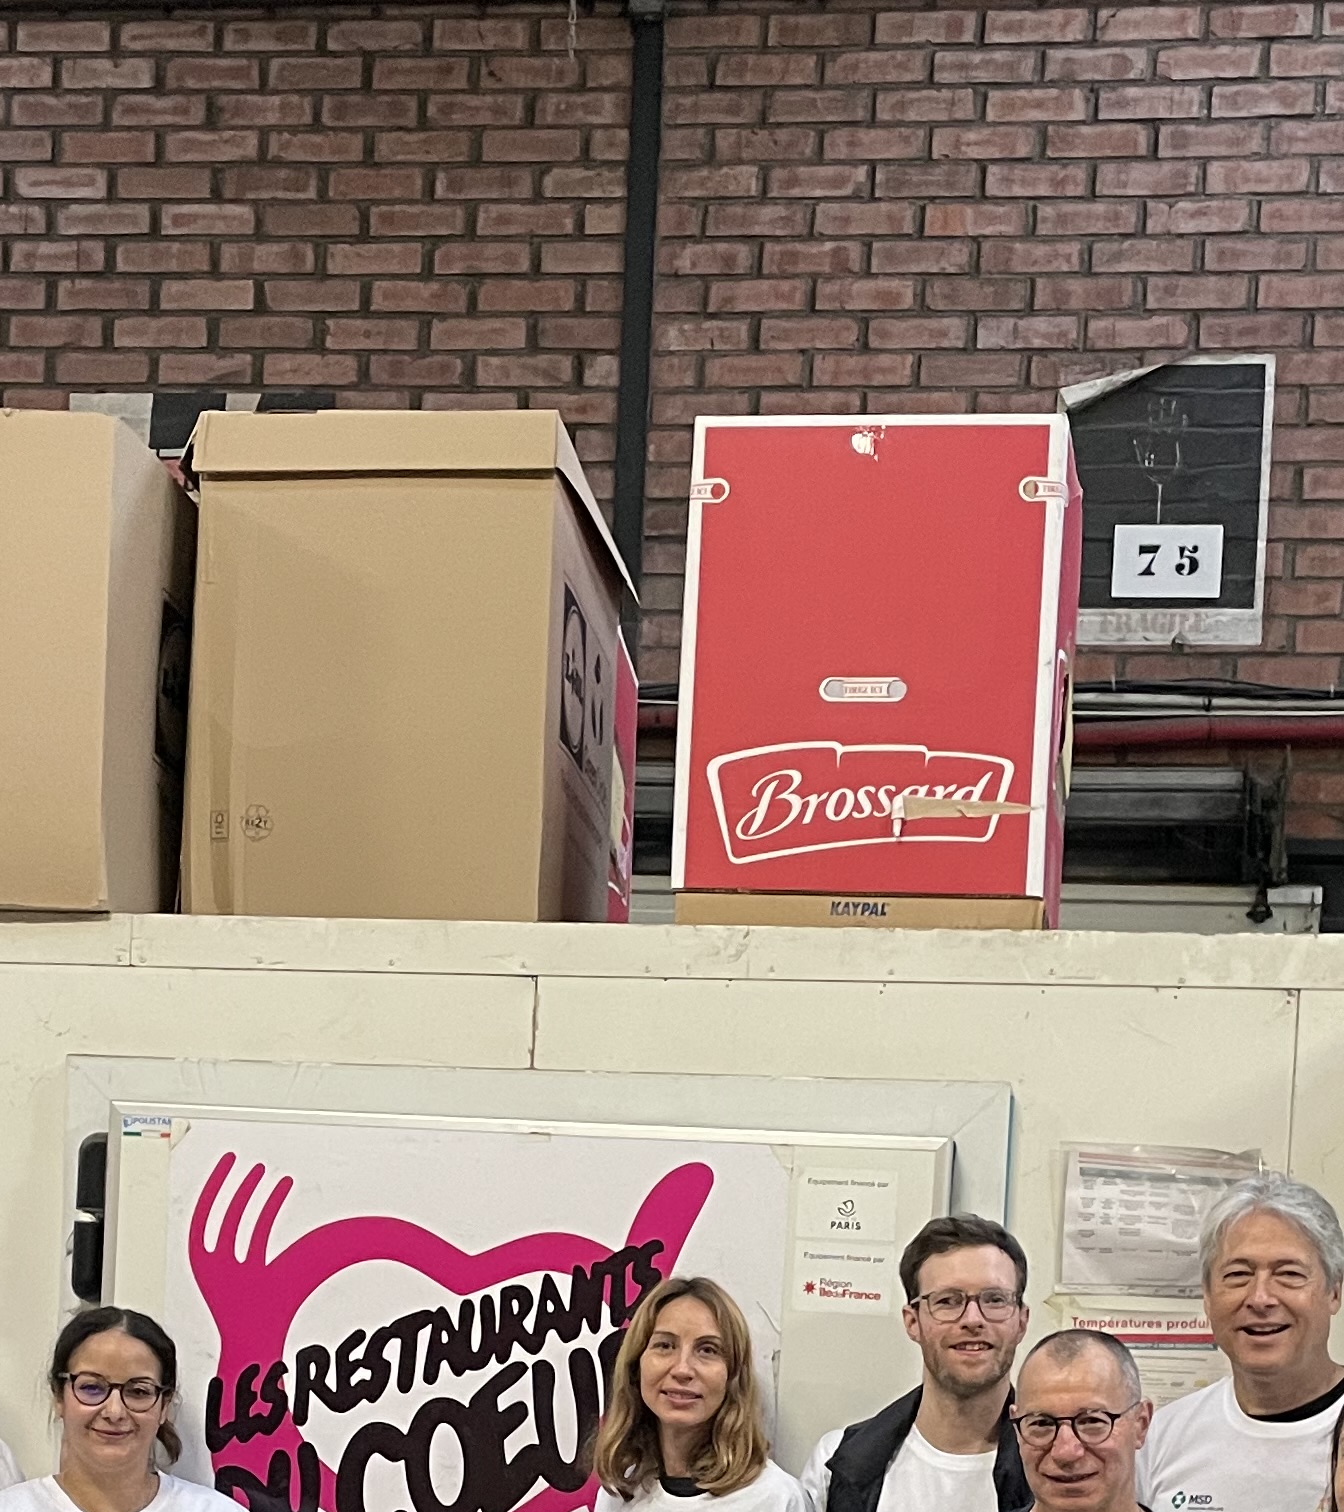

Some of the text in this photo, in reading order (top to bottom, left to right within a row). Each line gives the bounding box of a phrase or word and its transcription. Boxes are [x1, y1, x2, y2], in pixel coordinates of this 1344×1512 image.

[830, 901, 888, 917] KAYPAL
[830, 1220, 862, 1231] PARIS
[819, 1277, 853, 1290] Région
[1072, 1316, 1163, 1330] Températures
[206, 1239, 665, 1453] LES RESTAURANTS
[1188, 1494, 1213, 1505] MSD
